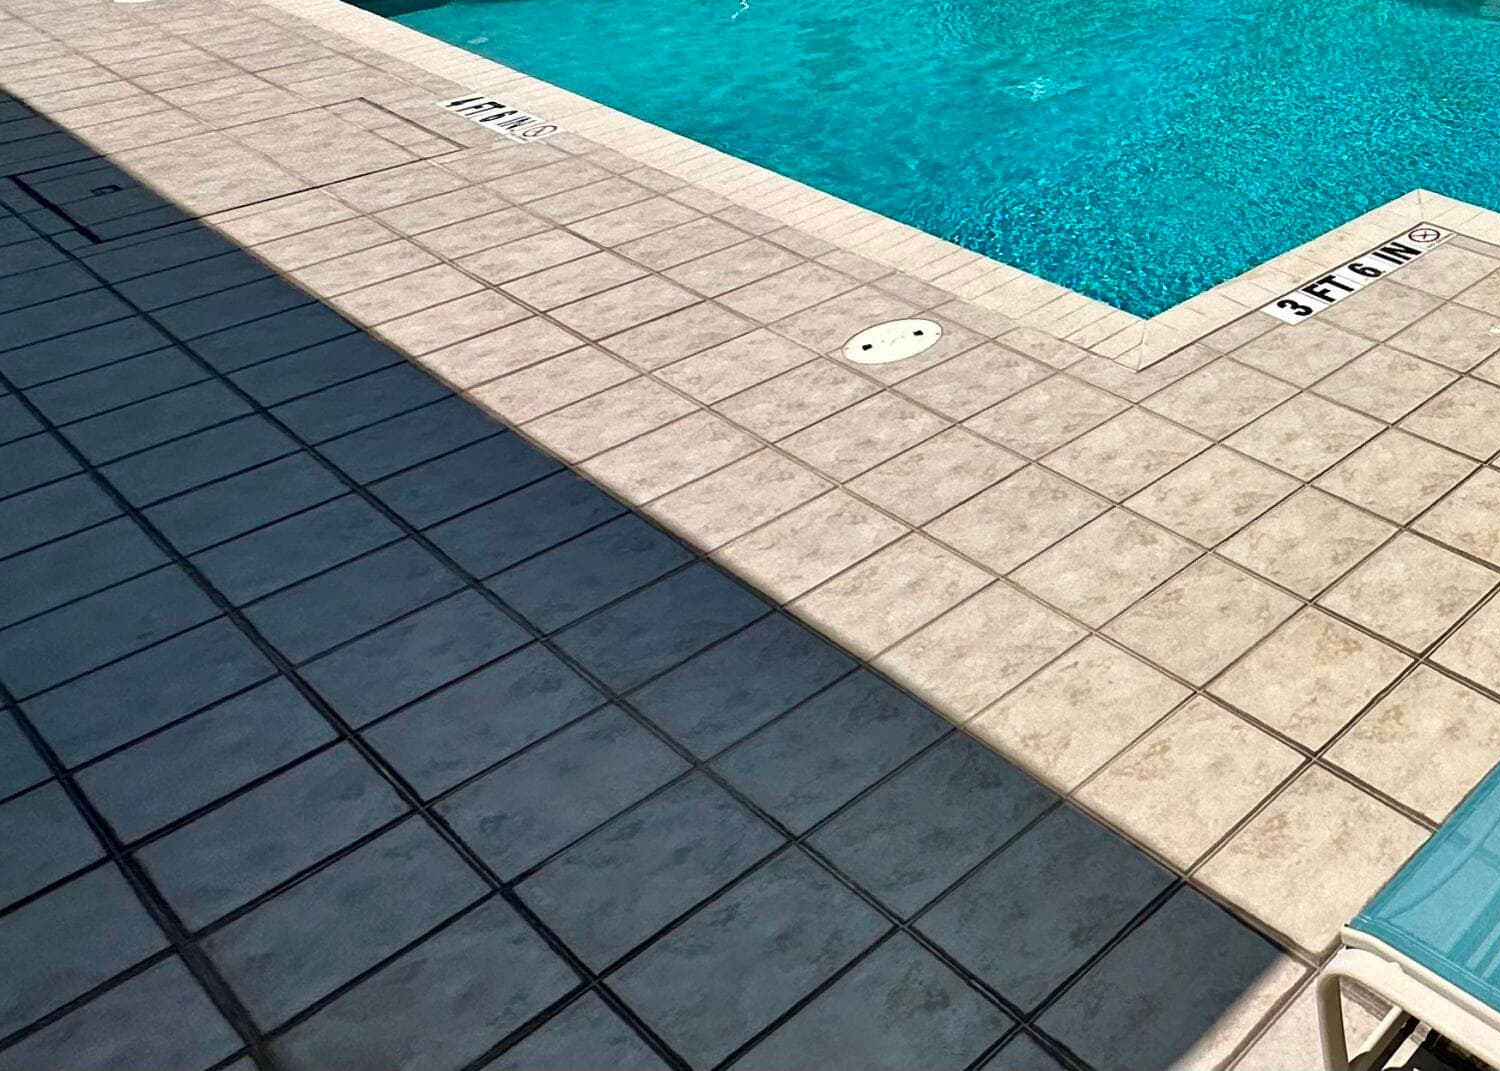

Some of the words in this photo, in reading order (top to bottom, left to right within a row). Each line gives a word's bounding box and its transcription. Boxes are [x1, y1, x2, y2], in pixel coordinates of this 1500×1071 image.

[455, 101, 506, 116] FT
[1277, 299, 1313, 316] 3
[1301, 275, 1354, 303] FT
[1348, 263, 1382, 278] 6
[1371, 242, 1422, 265] IN
